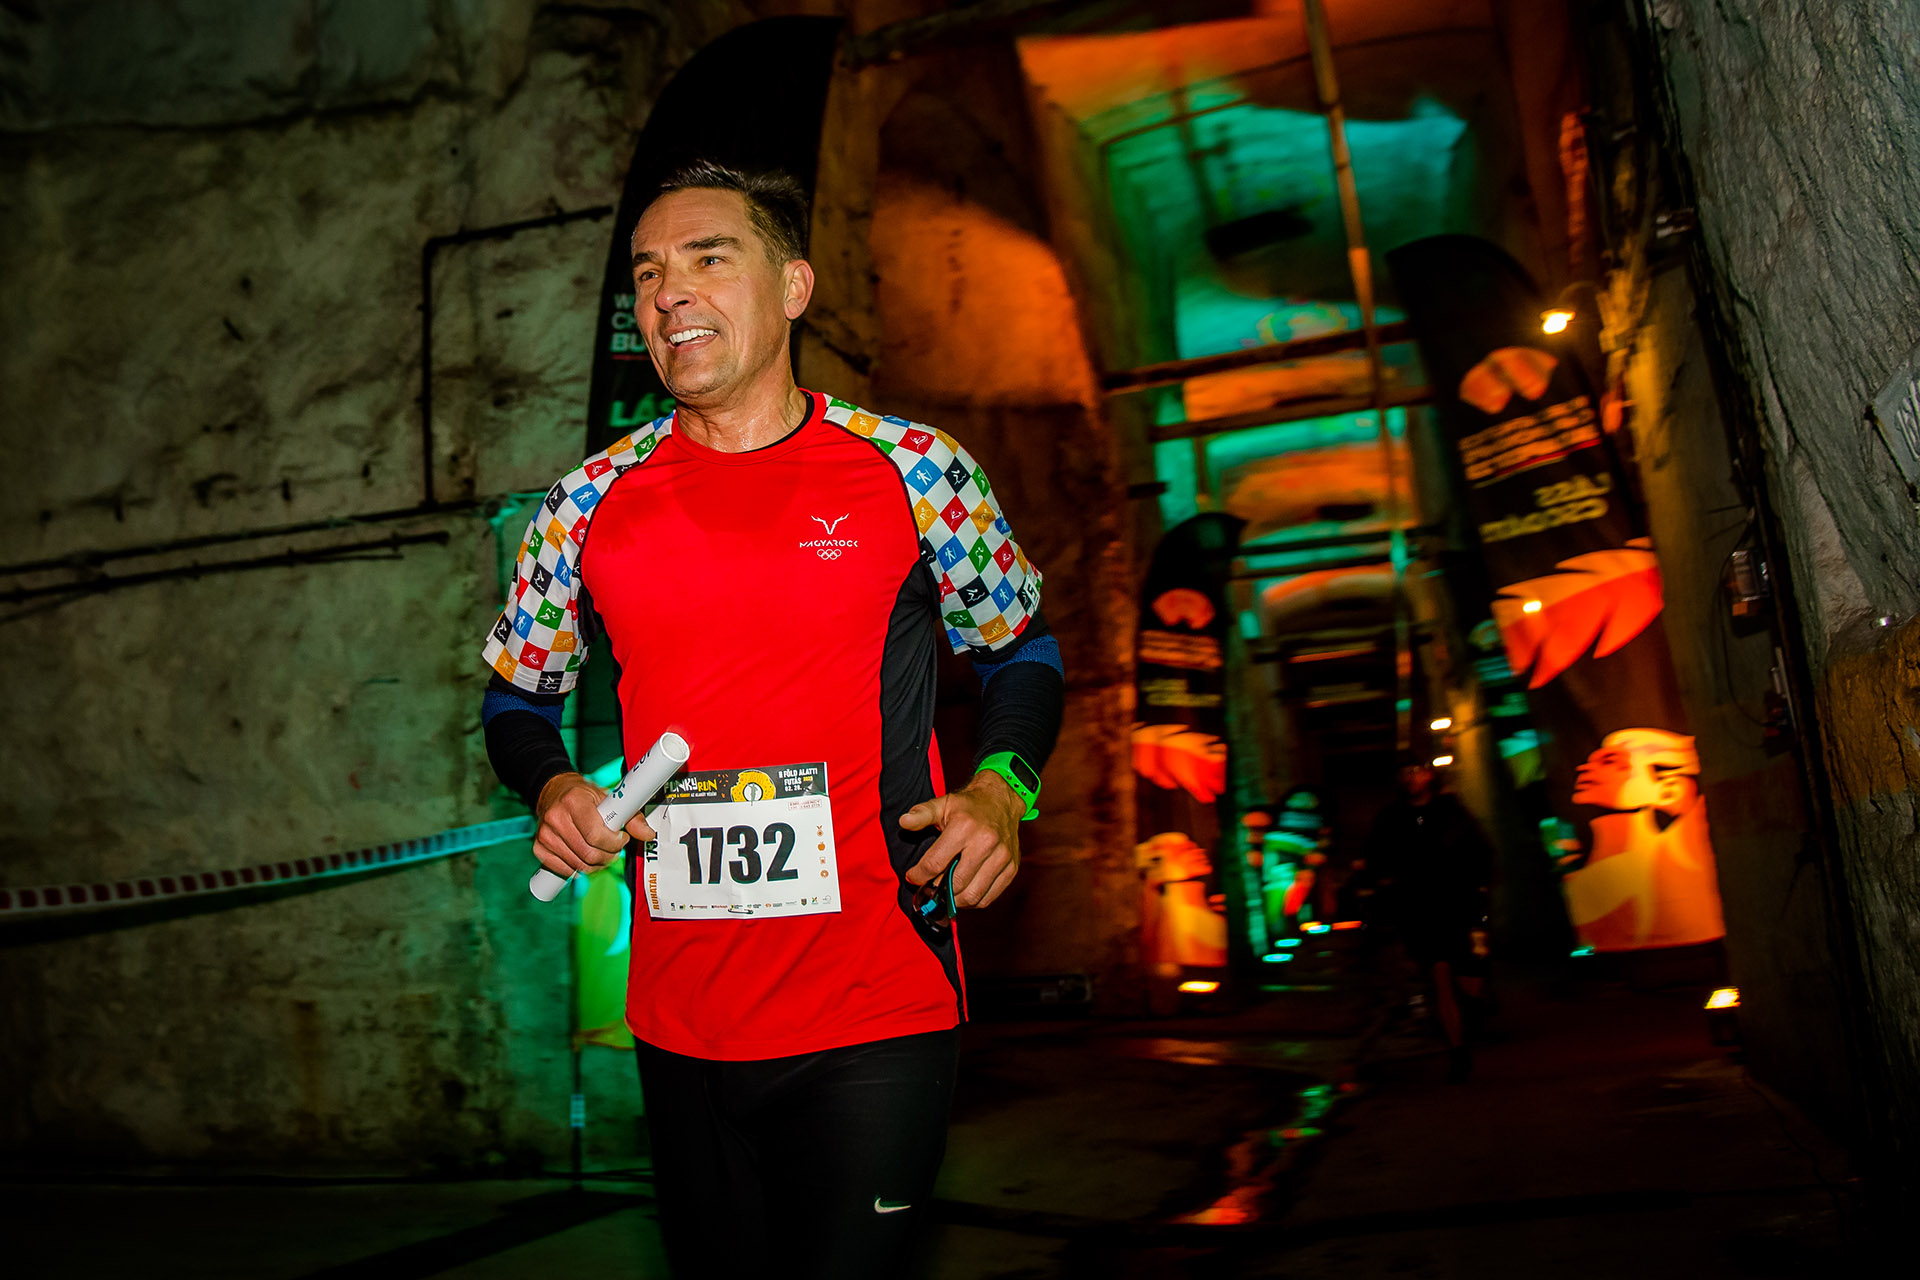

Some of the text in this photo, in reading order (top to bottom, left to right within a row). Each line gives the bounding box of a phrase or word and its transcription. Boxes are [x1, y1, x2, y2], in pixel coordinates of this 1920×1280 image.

[799, 539, 859, 548] MAGYAROCK
[697, 779, 718, 792] RUN
[784, 776, 802, 786] FUTÁS
[646, 831, 658, 863] 173
[679, 821, 799, 885] 1732
[648, 873, 660, 910] RUHATÁR
